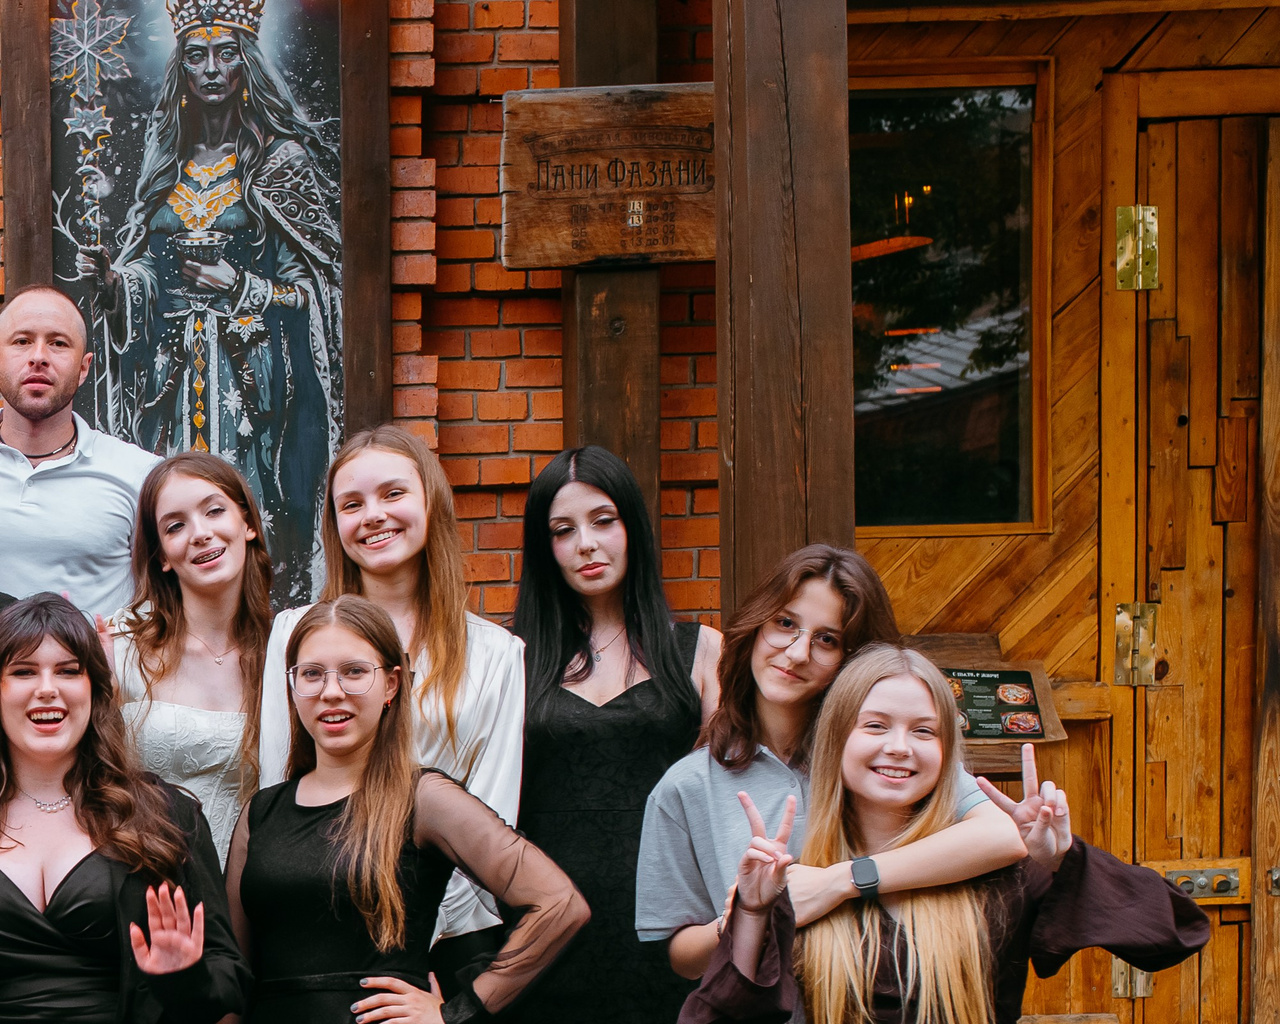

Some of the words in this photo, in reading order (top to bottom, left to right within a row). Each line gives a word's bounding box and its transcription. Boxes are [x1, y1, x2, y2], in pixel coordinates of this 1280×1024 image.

[536, 159, 599, 192] ПАНИ
[606, 157, 707, 188] ФАЗАНИ
[631, 202, 642, 210] 13
[631, 215, 642, 224] 13
[662, 225, 676, 234] 02
[631, 237, 642, 247] 13
[662, 236, 675, 246] 01
